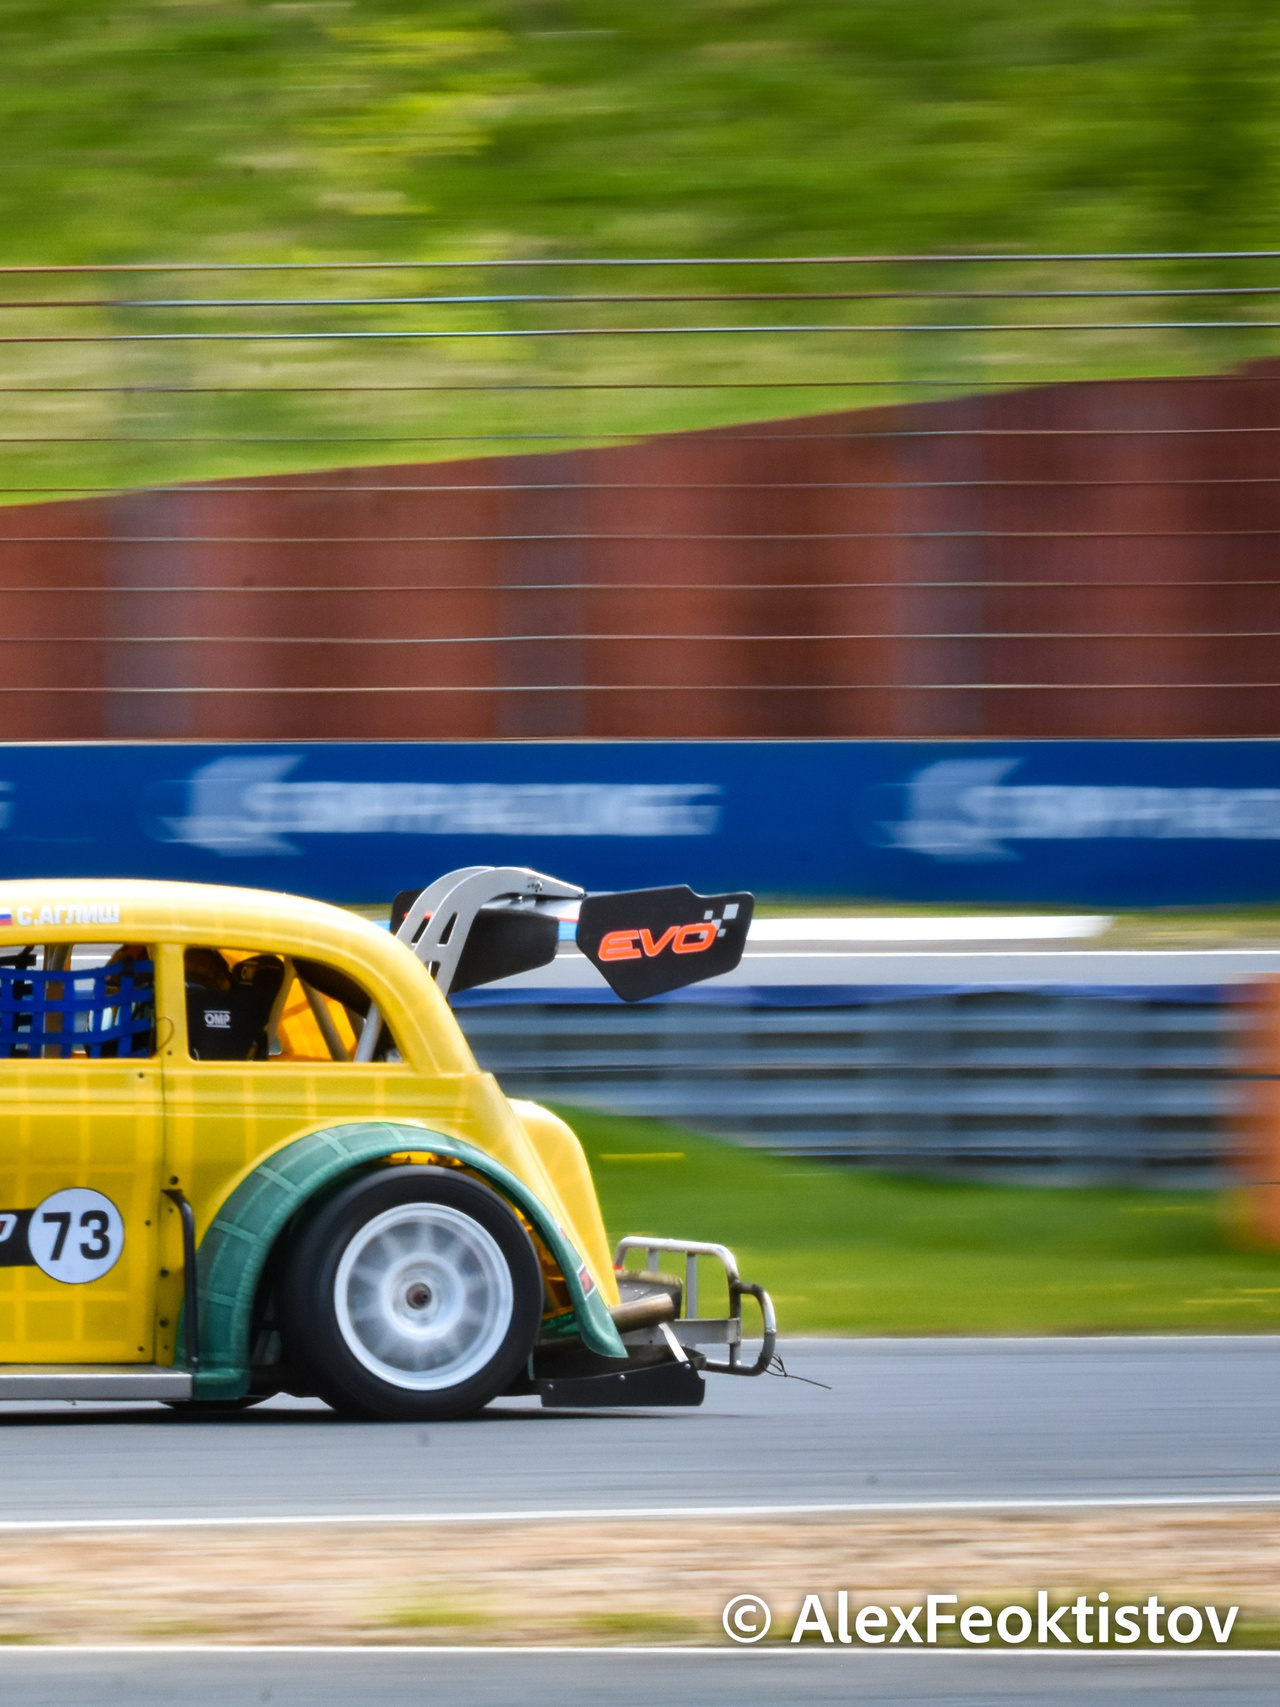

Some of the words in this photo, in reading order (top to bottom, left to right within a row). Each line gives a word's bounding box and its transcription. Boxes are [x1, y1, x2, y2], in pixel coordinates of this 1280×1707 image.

[17, 903, 120, 926] С.АГЛИШ
[598, 922, 717, 962] EVO
[204, 1013, 231, 1026] OMP
[42, 1210, 111, 1262] 73
